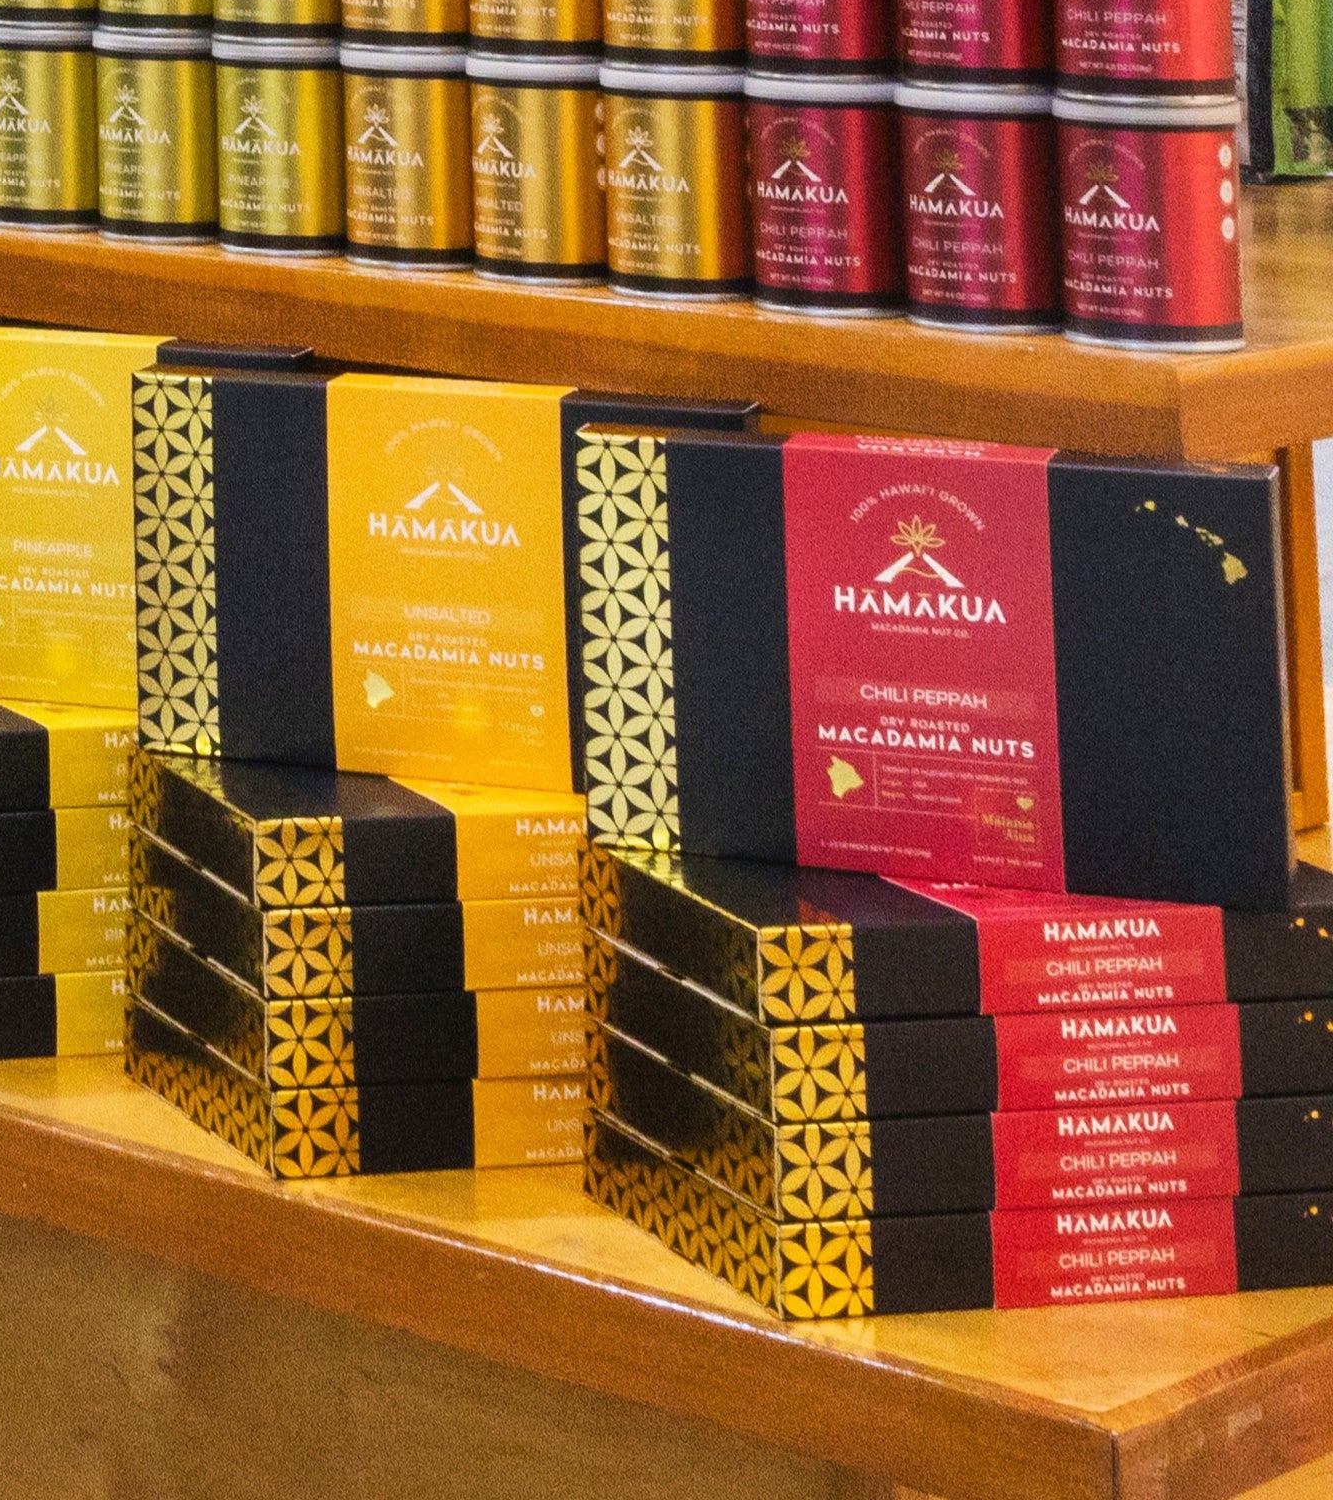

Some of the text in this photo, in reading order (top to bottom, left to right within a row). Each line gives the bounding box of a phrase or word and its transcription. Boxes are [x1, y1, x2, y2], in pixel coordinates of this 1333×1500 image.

[673, 14, 709, 26] NUTS
[1067, 9, 1166, 23] CHILI PEPPAH
[1062, 39, 1180, 53] MACADAMIA NUTS
[943, 239, 1003, 256] PEPPAH
[908, 265, 1017, 283] MACADAMIA NUTS
[849, 498, 877, 523] 100%
[938, 490, 986, 531] GROWN
[13, 540, 93, 559] PINEAPPLE
[403, 605, 490, 625] UNSALTED
[871, 623, 929, 636] MACADAMIA
[932, 627, 951, 638] NUT
[353, 641, 545, 671] MACADAMIA NUTS
[860, 684, 988, 710] CHILI PEPPAH
[880, 716, 971, 733] DRY ROASTED
[818, 724, 1035, 758] MACADAMIA NUTS
[1046, 957, 1163, 976] CHILI PEPPAH
[1038, 986, 1174, 1005] MACADAMIA NUTS
[1062, 1054, 1179, 1073] CHILI PEPPAH
[1054, 1083, 1190, 1102] MACADAMIA NUTS
[1060, 1151, 1177, 1171] CHILI PEPPAH
[1052, 1180, 1187, 1200] MACADAMIA NUTS
[1058, 1248, 1175, 1269] CHILI PEPPAH
[1050, 1278, 1186, 1298] MACADAMIA NUTS
